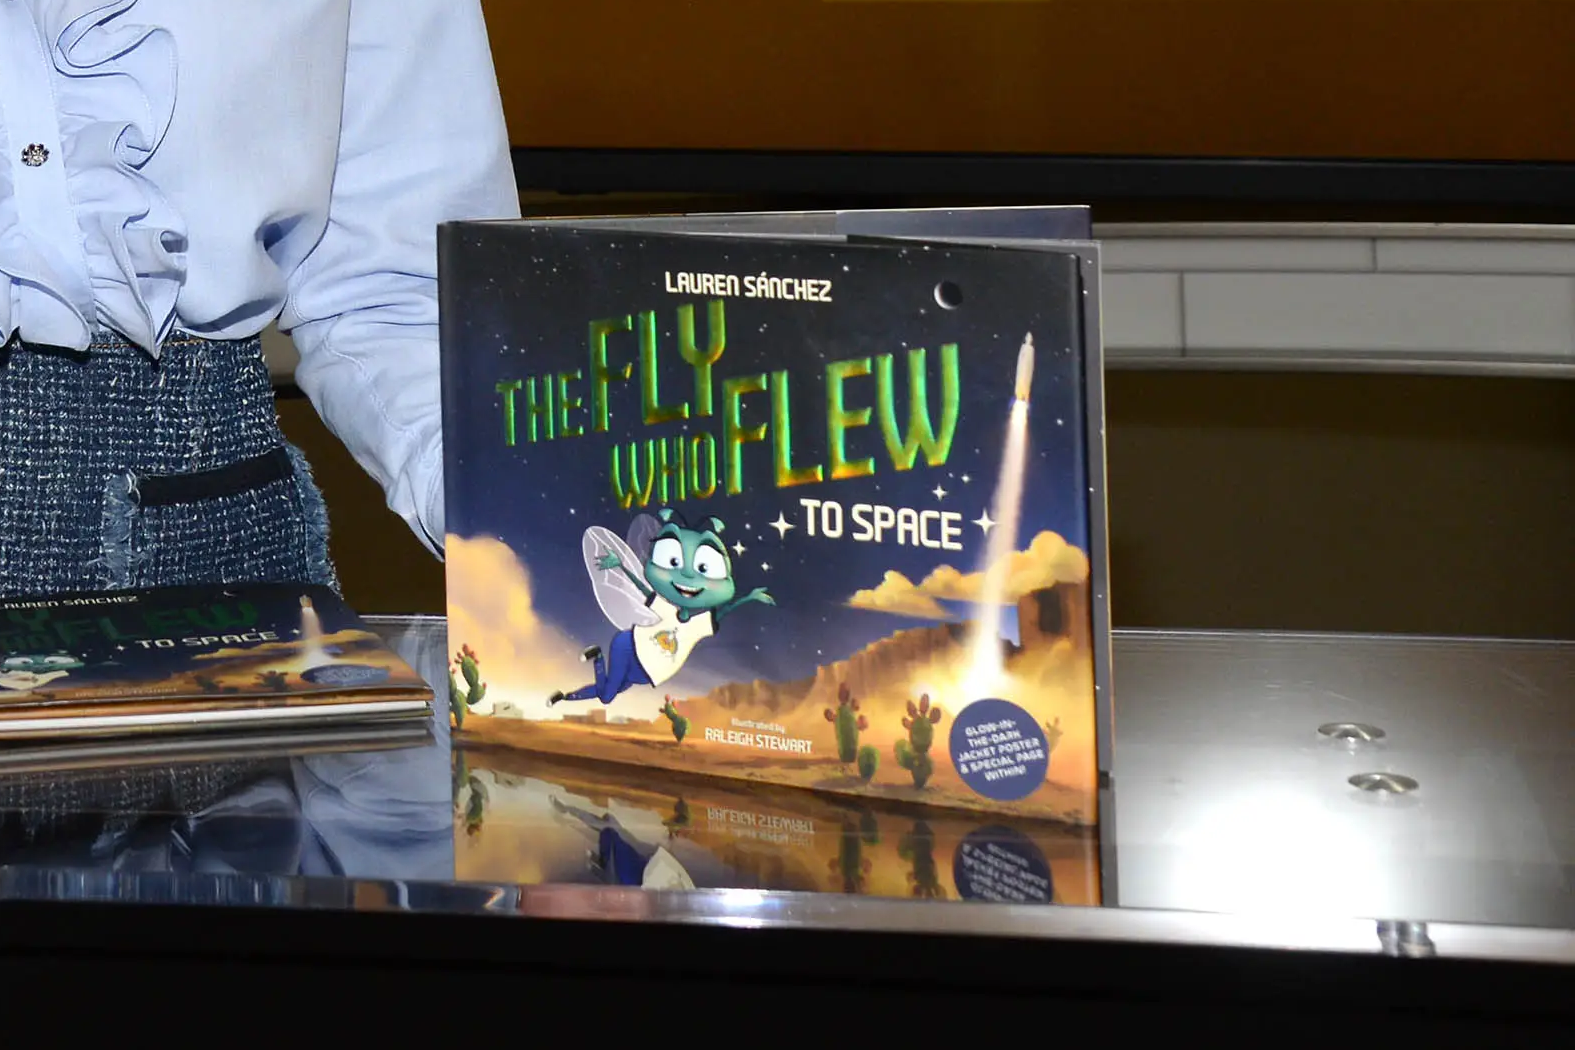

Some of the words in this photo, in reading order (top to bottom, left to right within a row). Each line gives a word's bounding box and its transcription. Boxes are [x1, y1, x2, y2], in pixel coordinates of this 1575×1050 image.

[665, 271, 739, 296] LAUREN
[744, 271, 832, 302] SÁNCHEZ
[496, 369, 583, 446] THE
[589, 300, 724, 432] FLY
[611, 432, 716, 509] WHO
[723, 343, 959, 494] FLEW
[800, 498, 843, 538] TO
[852, 504, 962, 550] SPACE
[135, 638, 175, 650] TO
[182, 631, 280, 647] SPACE
[705, 727, 753, 745] RALEIGH
[756, 734, 812, 753] STEWART
